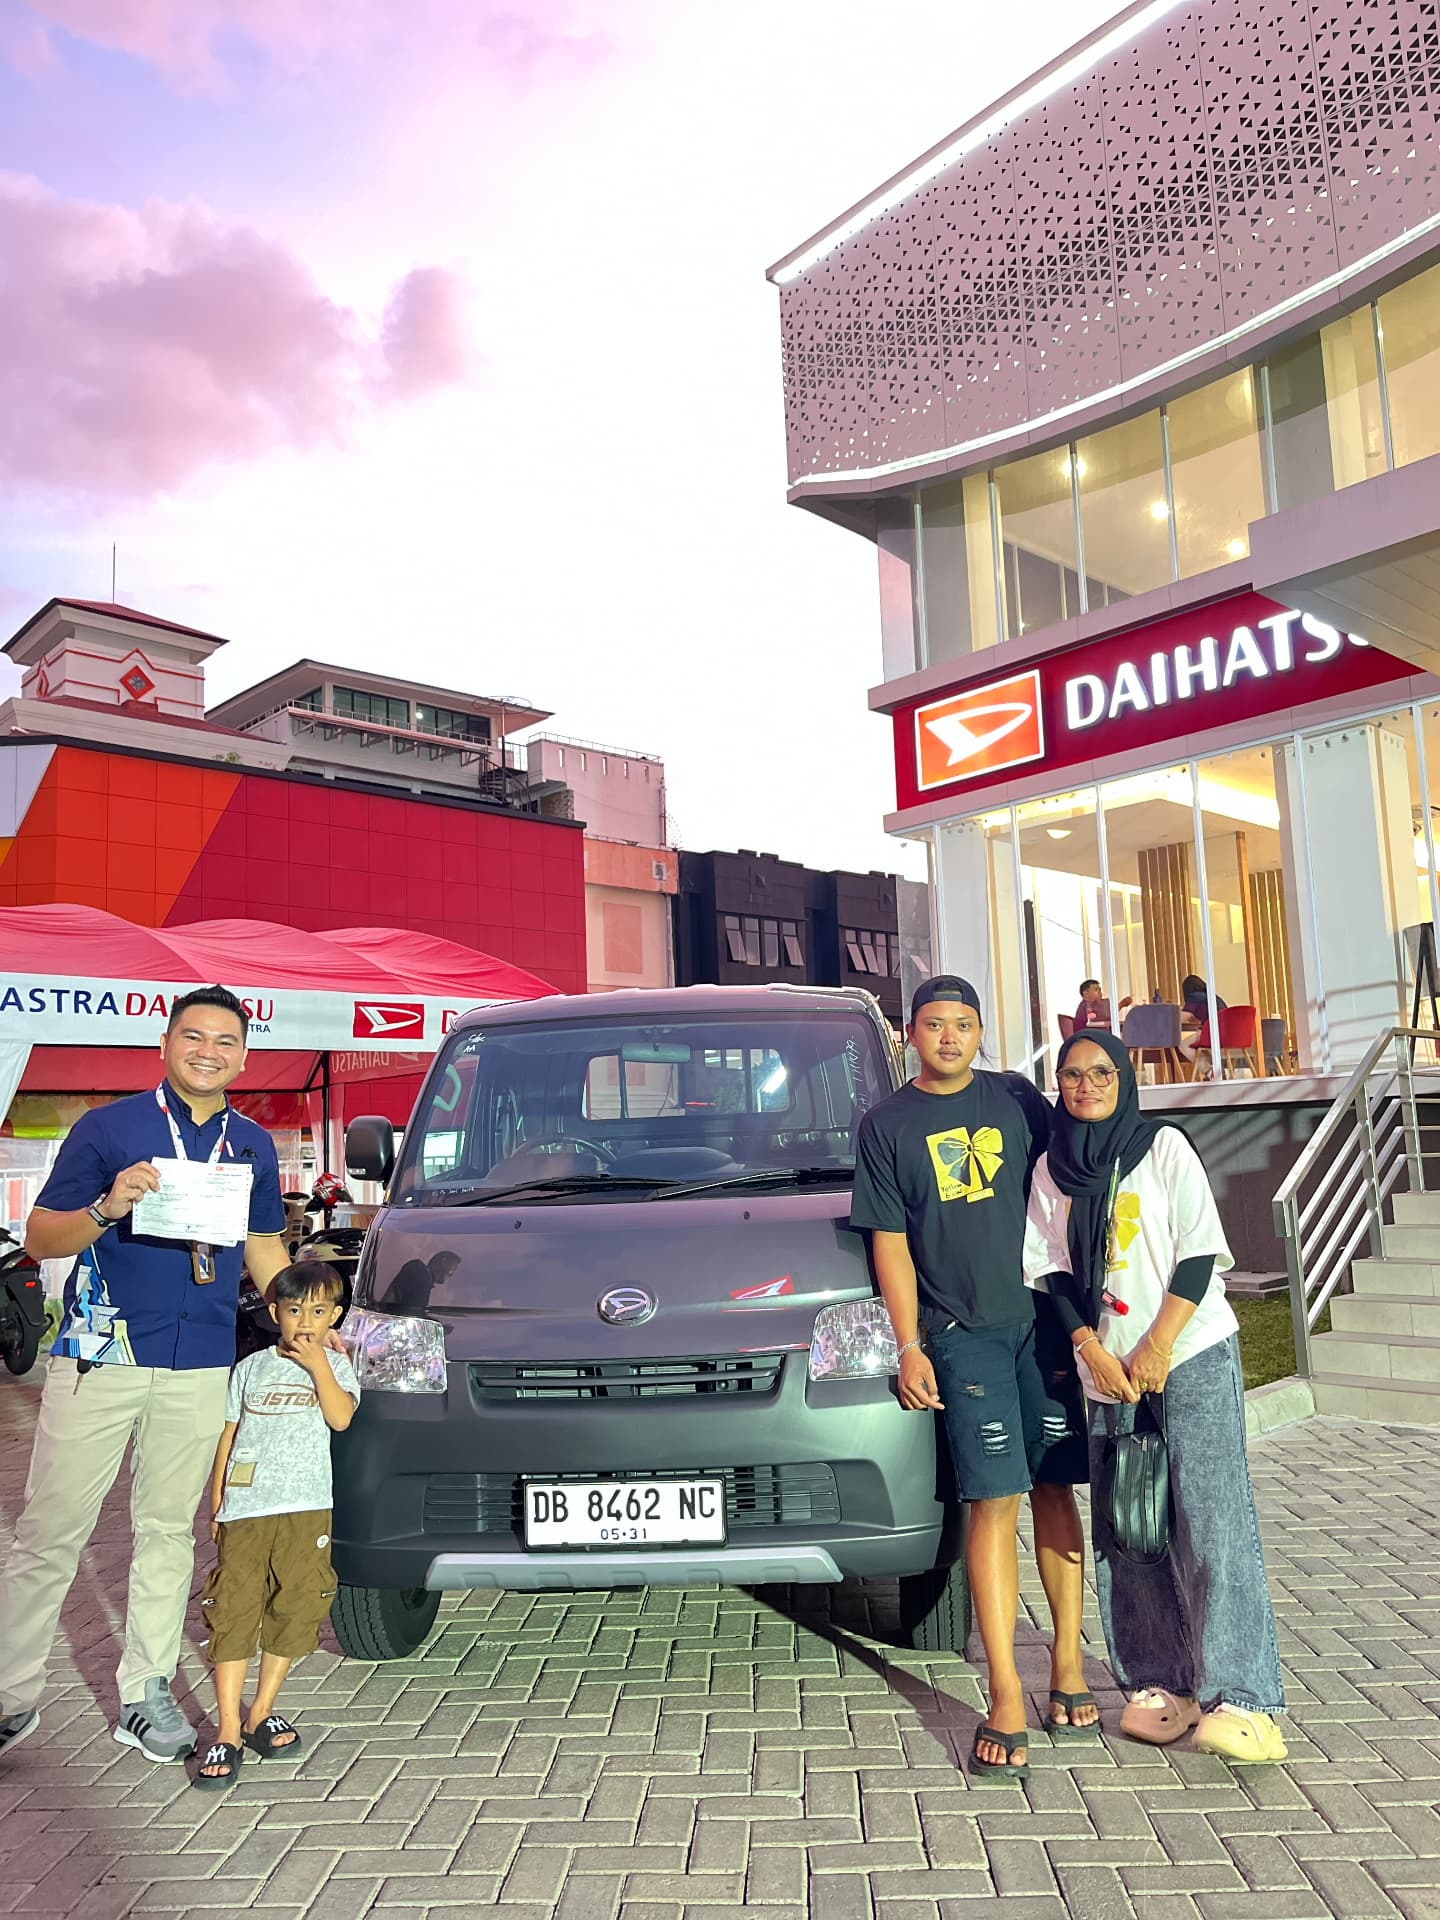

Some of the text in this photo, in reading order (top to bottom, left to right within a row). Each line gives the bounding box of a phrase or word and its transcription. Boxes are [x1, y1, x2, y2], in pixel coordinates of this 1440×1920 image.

[1065, 609, 1369, 731] DAIHATS
[125, 992, 274, 1021] DASU
[533, 1486, 715, 1523] DB 8462 NC
